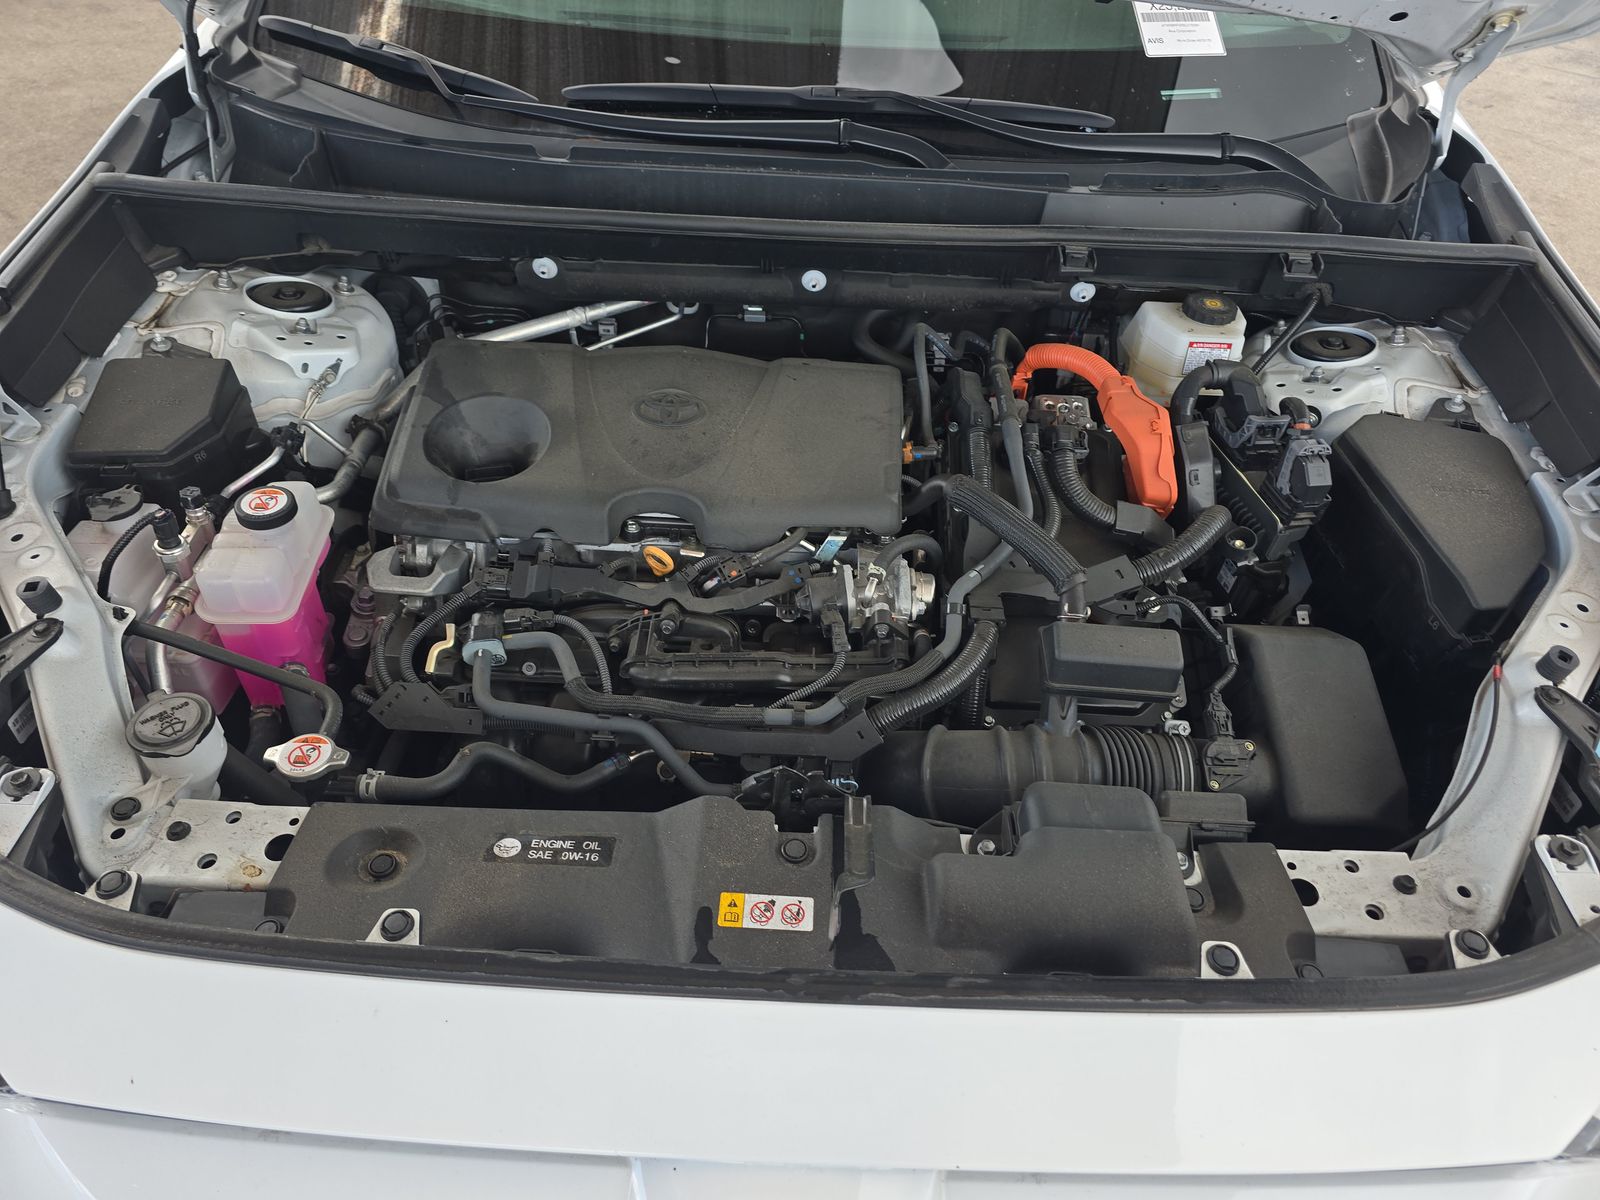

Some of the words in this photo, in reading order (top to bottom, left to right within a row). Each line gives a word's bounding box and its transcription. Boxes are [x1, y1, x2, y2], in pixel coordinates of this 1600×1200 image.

[193, 449, 207, 463] R6
[530, 839, 575, 849] ENGINE
[582, 841, 602, 850] OIL
[527, 850, 554, 860] SAE
[560, 851, 600, 862] 0W-16
